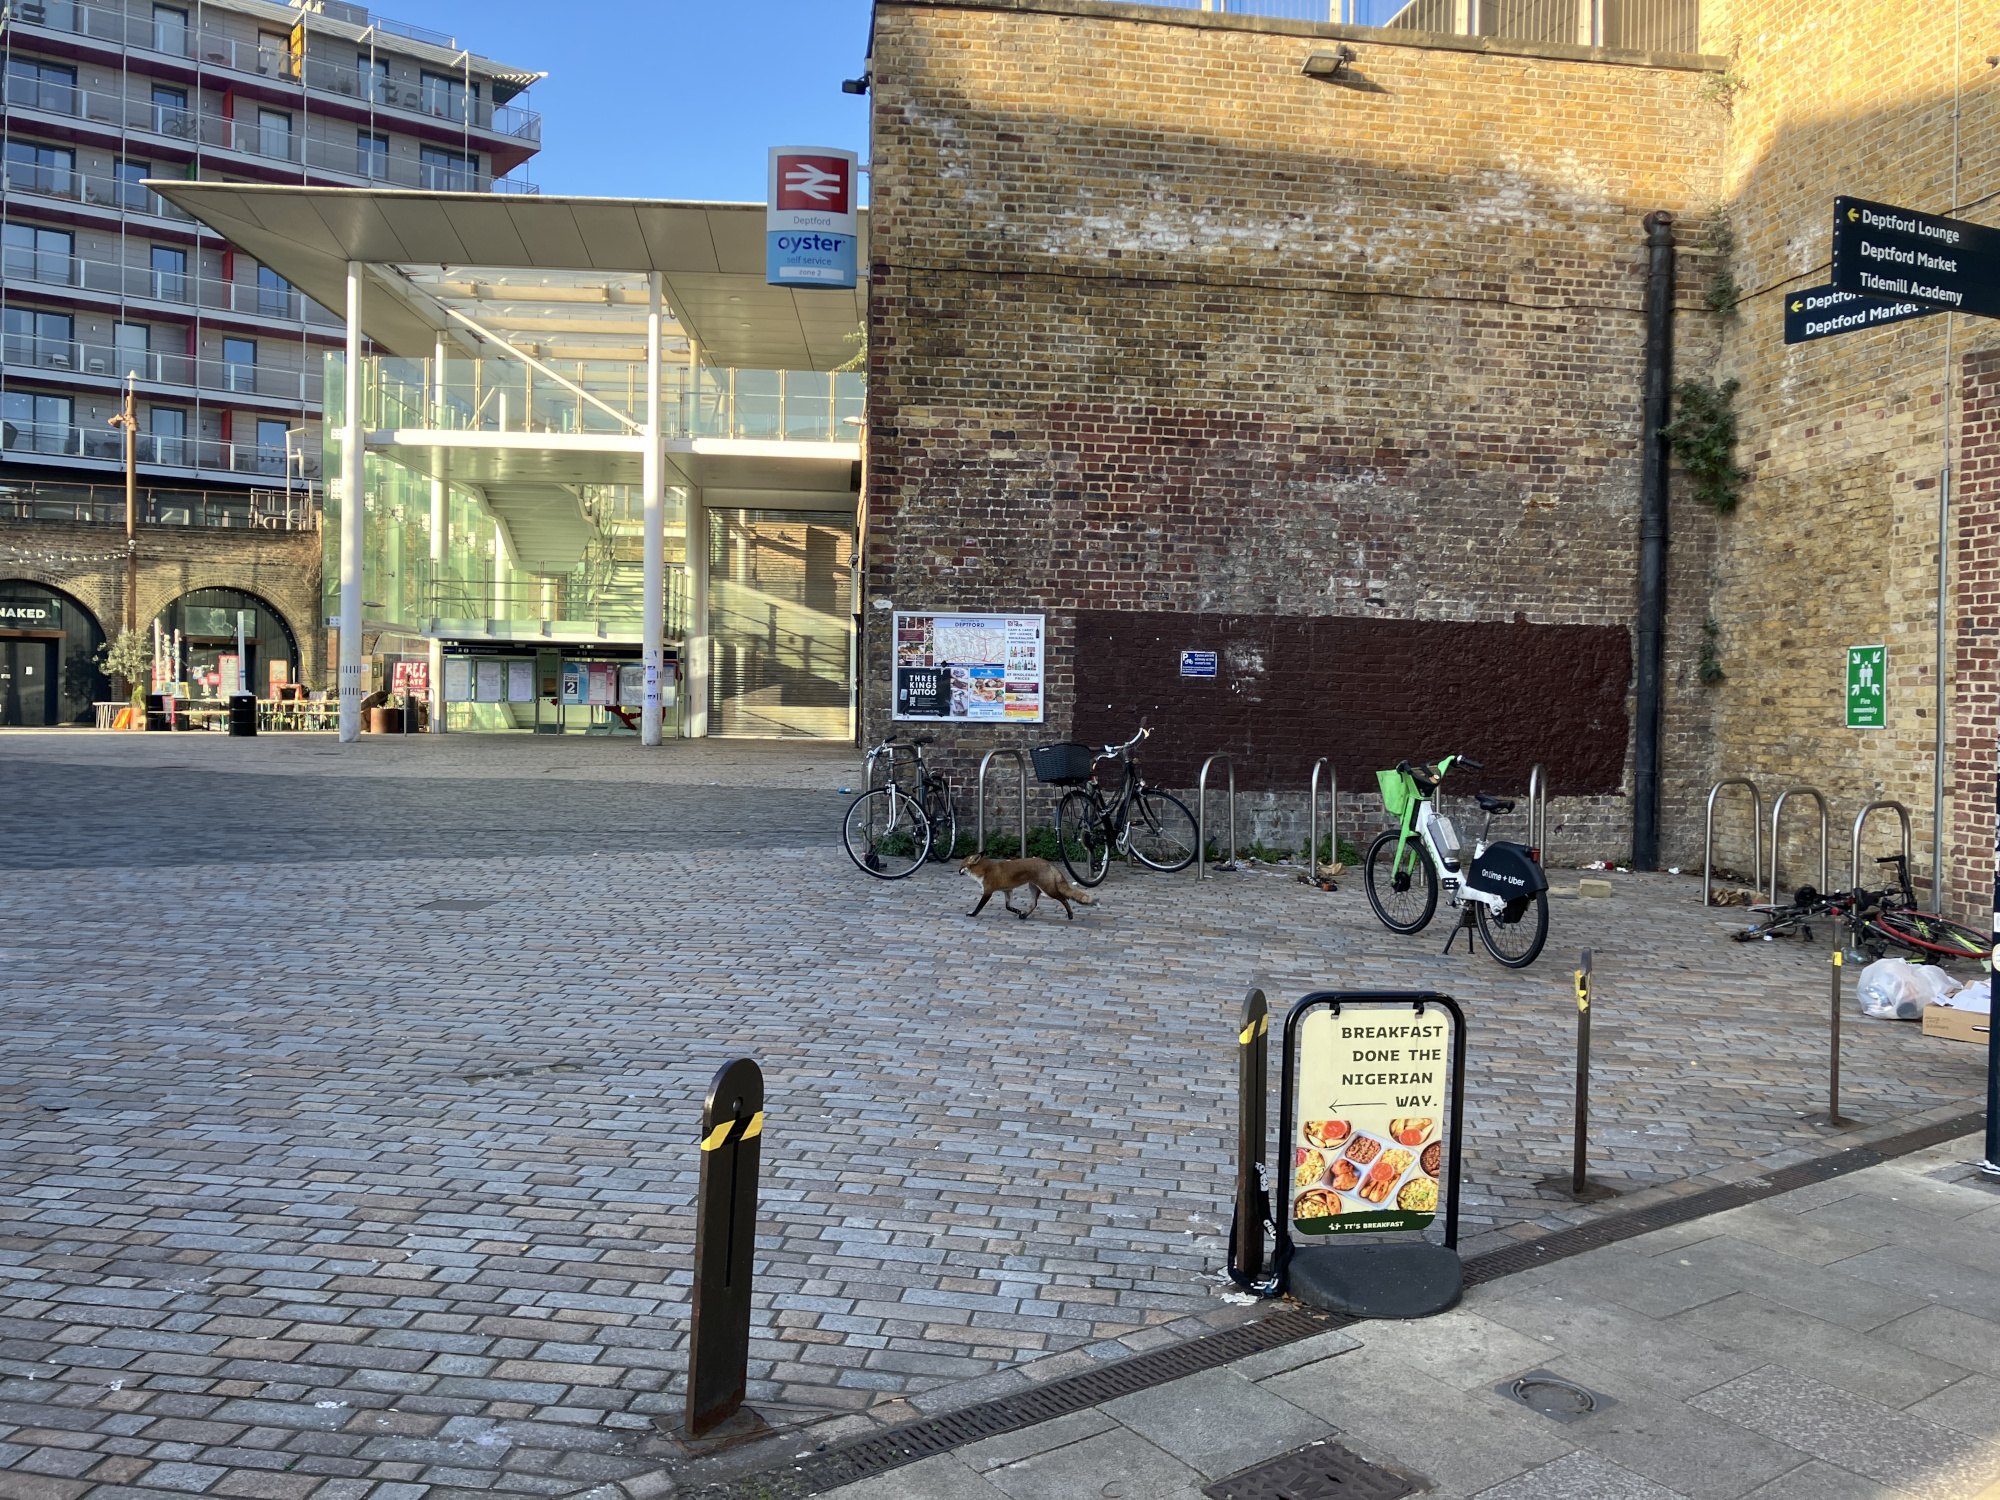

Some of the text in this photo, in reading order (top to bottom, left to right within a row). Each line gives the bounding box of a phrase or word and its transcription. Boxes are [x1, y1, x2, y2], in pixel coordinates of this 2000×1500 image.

[794, 216, 831, 226] Deptford
[1862, 210, 1960, 244] Deptford Lounge
[778, 234, 842, 254] oyster
[787, 255, 832, 266] self service
[1860, 241, 1958, 272] Deptford Market
[1860, 272, 1963, 306] Tidemill Academy
[1806, 303, 1919, 335] Deptford Market
[396, 662, 427, 678] FREE
[567, 682, 575, 693] 2
[1508, 876, 1525, 886] Uber
[1341, 1026, 1444, 1039] BREAKFAST
[1352, 1049, 1442, 1062] DONE THE
[1341, 1072, 1433, 1086] NIGERIAN
[1395, 1096, 1438, 1108] WAY.
